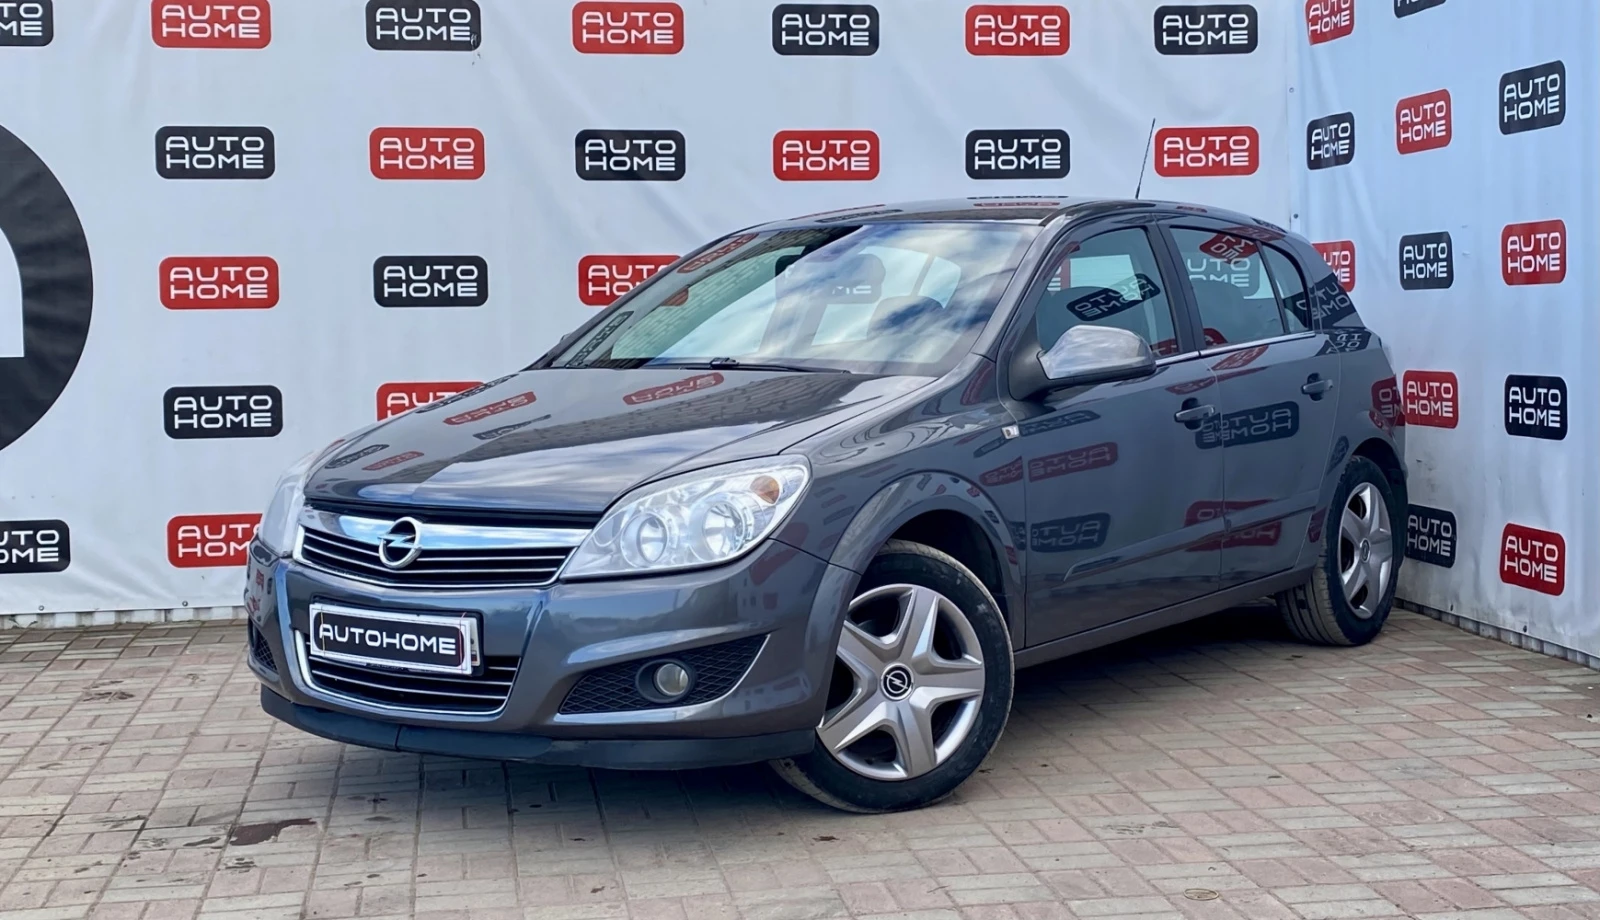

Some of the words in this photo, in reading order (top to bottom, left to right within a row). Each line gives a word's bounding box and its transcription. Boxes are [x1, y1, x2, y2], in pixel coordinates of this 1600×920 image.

[162, 4, 261, 21] AUTO
[376, 8, 471, 23] AUTO
[582, 11, 674, 27] AUTO
[782, 14, 870, 29] AUTO
[974, 14, 1061, 29] AUTO
[1162, 14, 1249, 29] AUTO
[1308, 10, 1350, 36] HOME
[162, 22, 260, 38] HOME
[376, 25, 470, 41] HOME
[582, 28, 674, 44] HOME
[782, 30, 869, 46] HOME
[1162, 30, 1248, 46] HOME
[974, 31, 1060, 46] HOME
[1504, 74, 1560, 102] AUTO
[1400, 100, 1446, 125] AUTO
[1504, 94, 1560, 122] HOME
[1312, 122, 1351, 144] AUTO
[1400, 120, 1446, 144] HOME
[166, 136, 264, 152] AUTO
[380, 137, 475, 152] AUTO
[585, 139, 676, 154] AUTO
[782, 140, 870, 154] AUTO
[974, 138, 1062, 153] AUTO
[1164, 136, 1250, 151] AUTO
[1311, 139, 1350, 160] HOME
[166, 154, 264, 169] HOME
[380, 154, 474, 170] HOME
[585, 156, 675, 171] HOME
[782, 156, 870, 171] HOME
[974, 155, 1061, 170] HOME
[1164, 152, 1249, 167] HOME
[1507, 232, 1561, 253] AUTO
[1403, 242, 1448, 261] AUTO
[1404, 262, 1447, 279] HOME
[1508, 253, 1560, 273] HOME
[170, 266, 268, 282] AUTO
[384, 265, 478, 280] AUTO
[170, 284, 268, 299] HOME
[384, 282, 478, 297] HOME
[1407, 381, 1453, 398] AUTO
[1509, 386, 1561, 406] AUTO
[174, 395, 272, 412] AUTO
[1407, 400, 1453, 417] HOME
[174, 412, 272, 429] HOME
[1509, 406, 1560, 428] HOME
[1407, 515, 1452, 537] AUTO
[1407, 531, 1451, 557] HOME
[1506, 536, 1558, 562] AUTO
[1504, 555, 1557, 583] HOME
[319, 623, 457, 655] AUTOHOME
